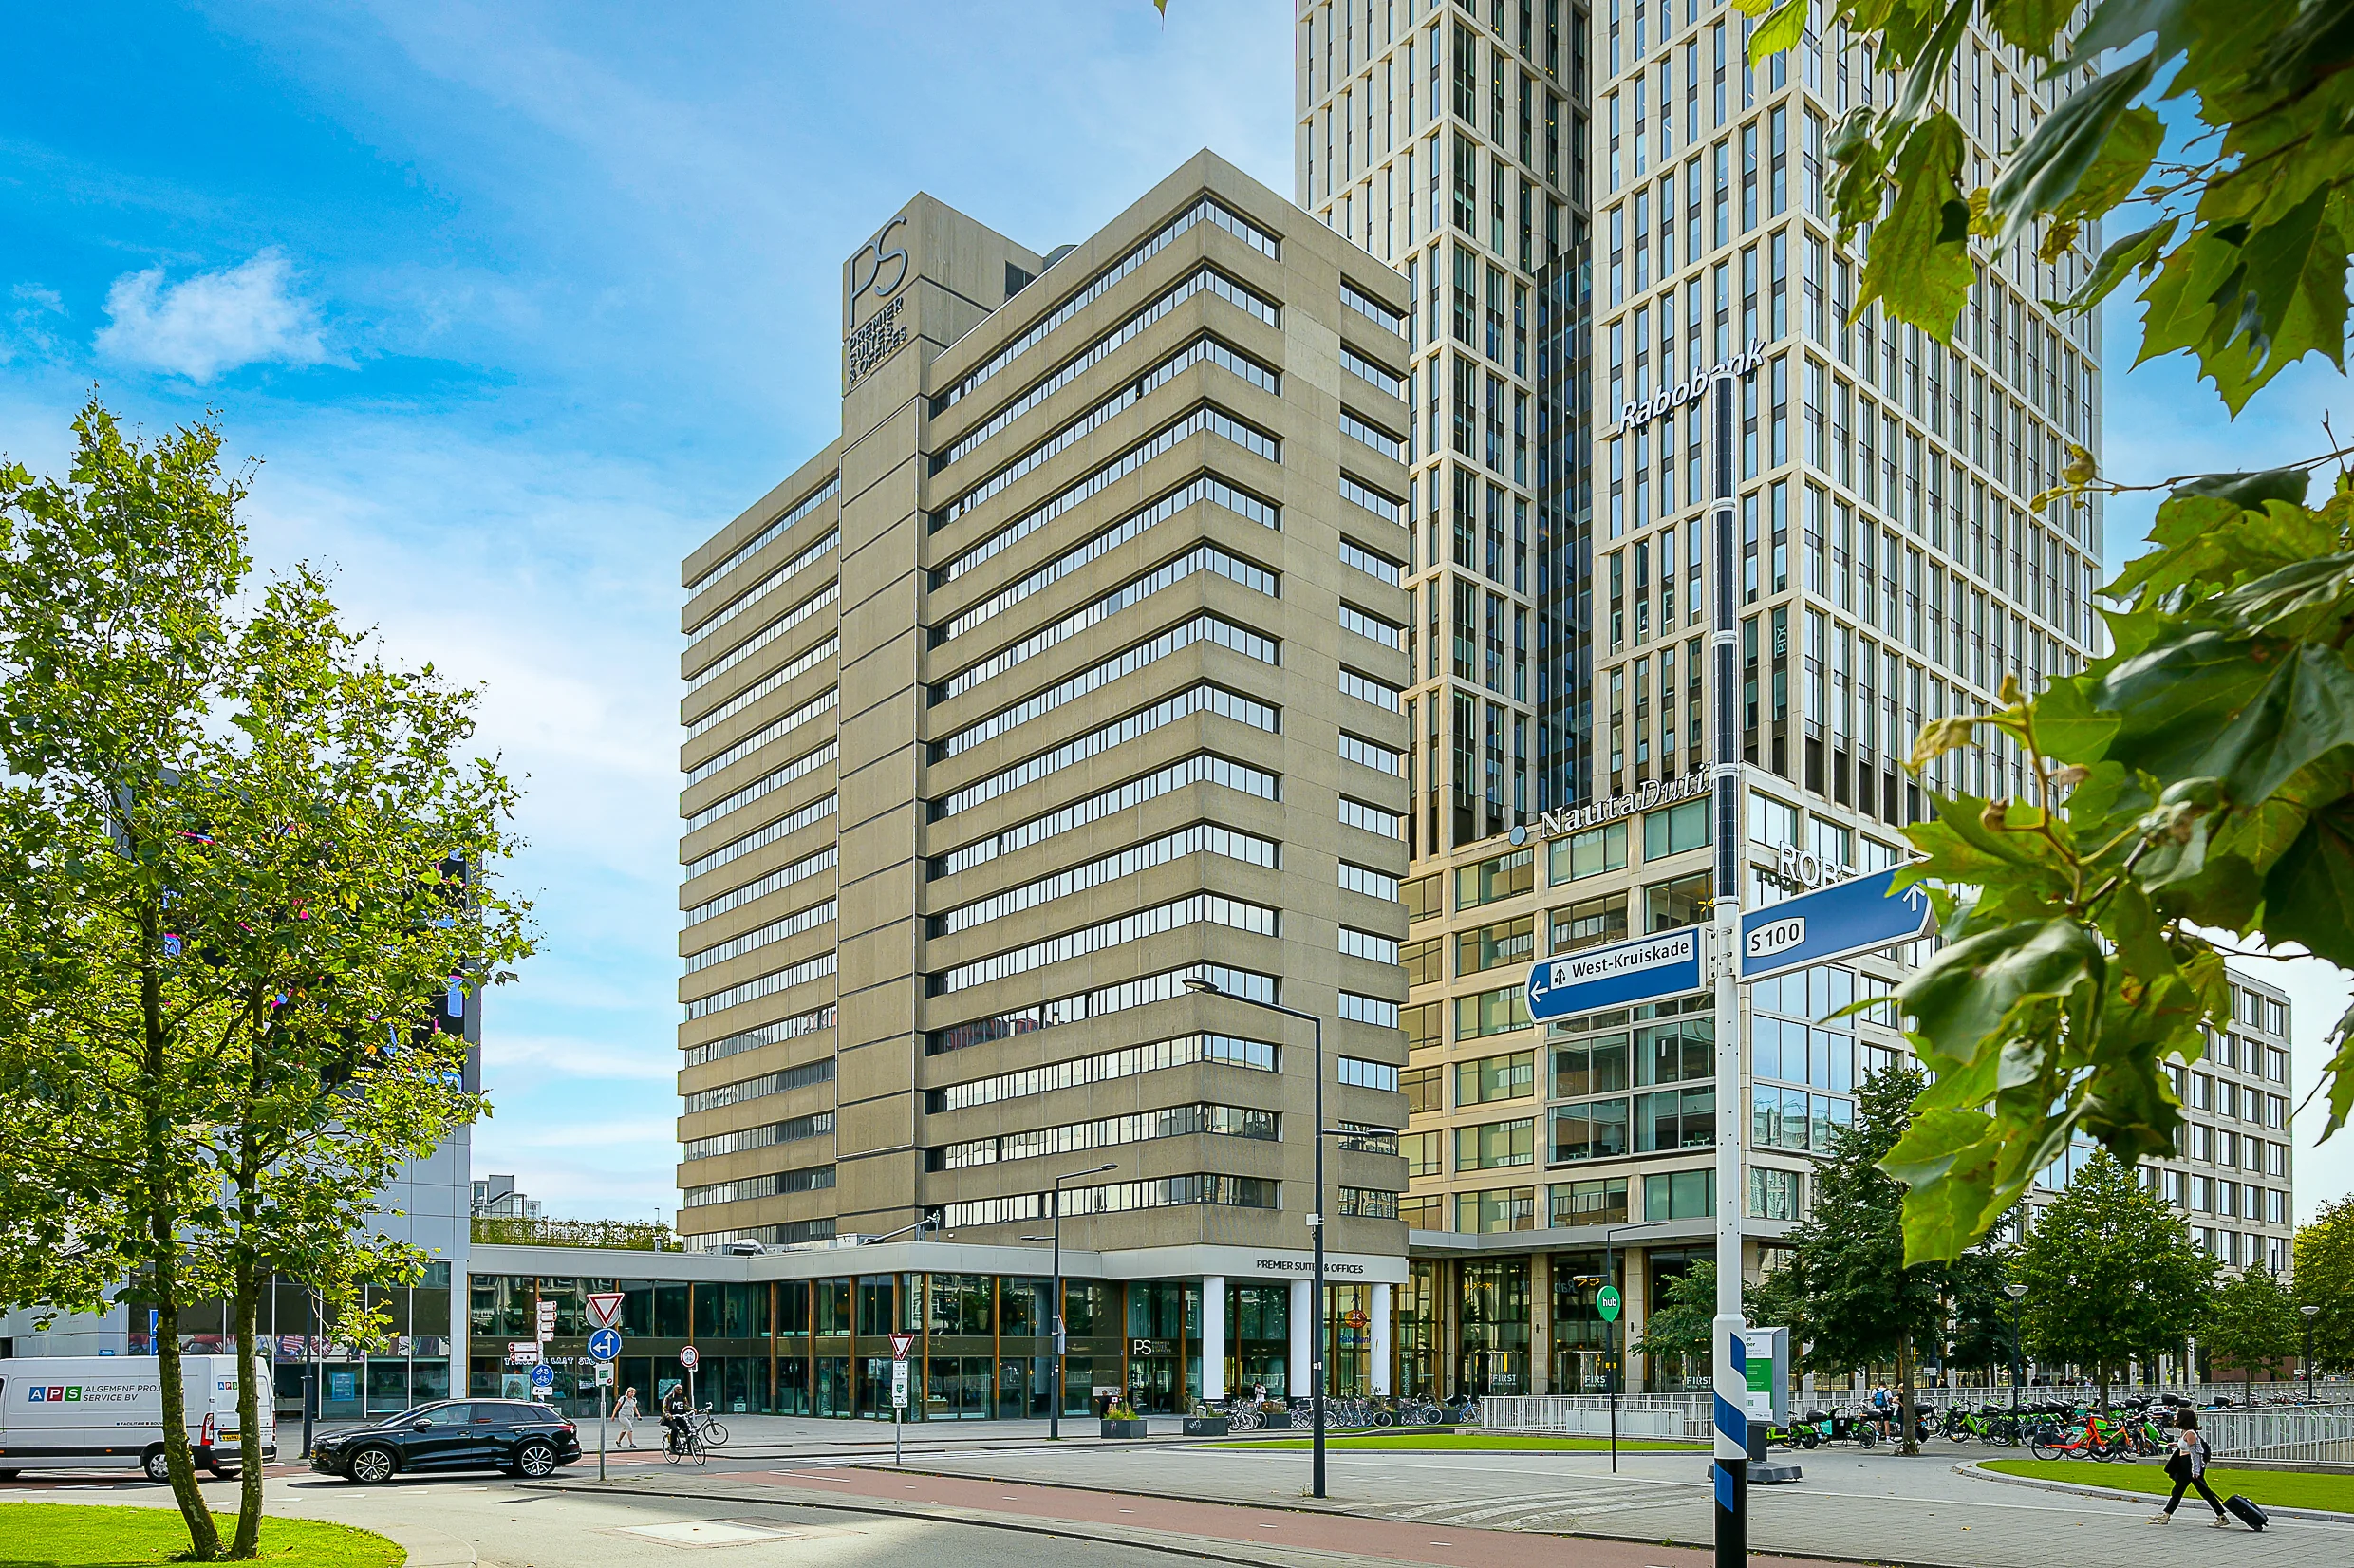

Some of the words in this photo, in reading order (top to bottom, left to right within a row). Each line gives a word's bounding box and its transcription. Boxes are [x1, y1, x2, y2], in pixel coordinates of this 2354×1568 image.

[850, 296, 904, 352] PREMIER
[850, 321, 894, 366] SUITES
[850, 368, 857, 383] &
[859, 325, 907, 374] OFFICES
[1540, 760, 1714, 840] NautaDutil
[1751, 935, 1761, 952] S
[1766, 923, 1801, 948] 100
[1572, 940, 1689, 978] West-Kruiskade
[1257, 1260, 1293, 1270] PREMIER
[1323, 1262, 1330, 1272] &
[1331, 1263, 1364, 1274] OFFICES
[1602, 1297, 1617, 1307] hub
[1133, 1339, 1152, 1355] PS
[30, 1388, 81, 1401] APS
[137, 1384, 161, 1392] PROJ
[1686, 1376, 1712, 1385] FIRST
